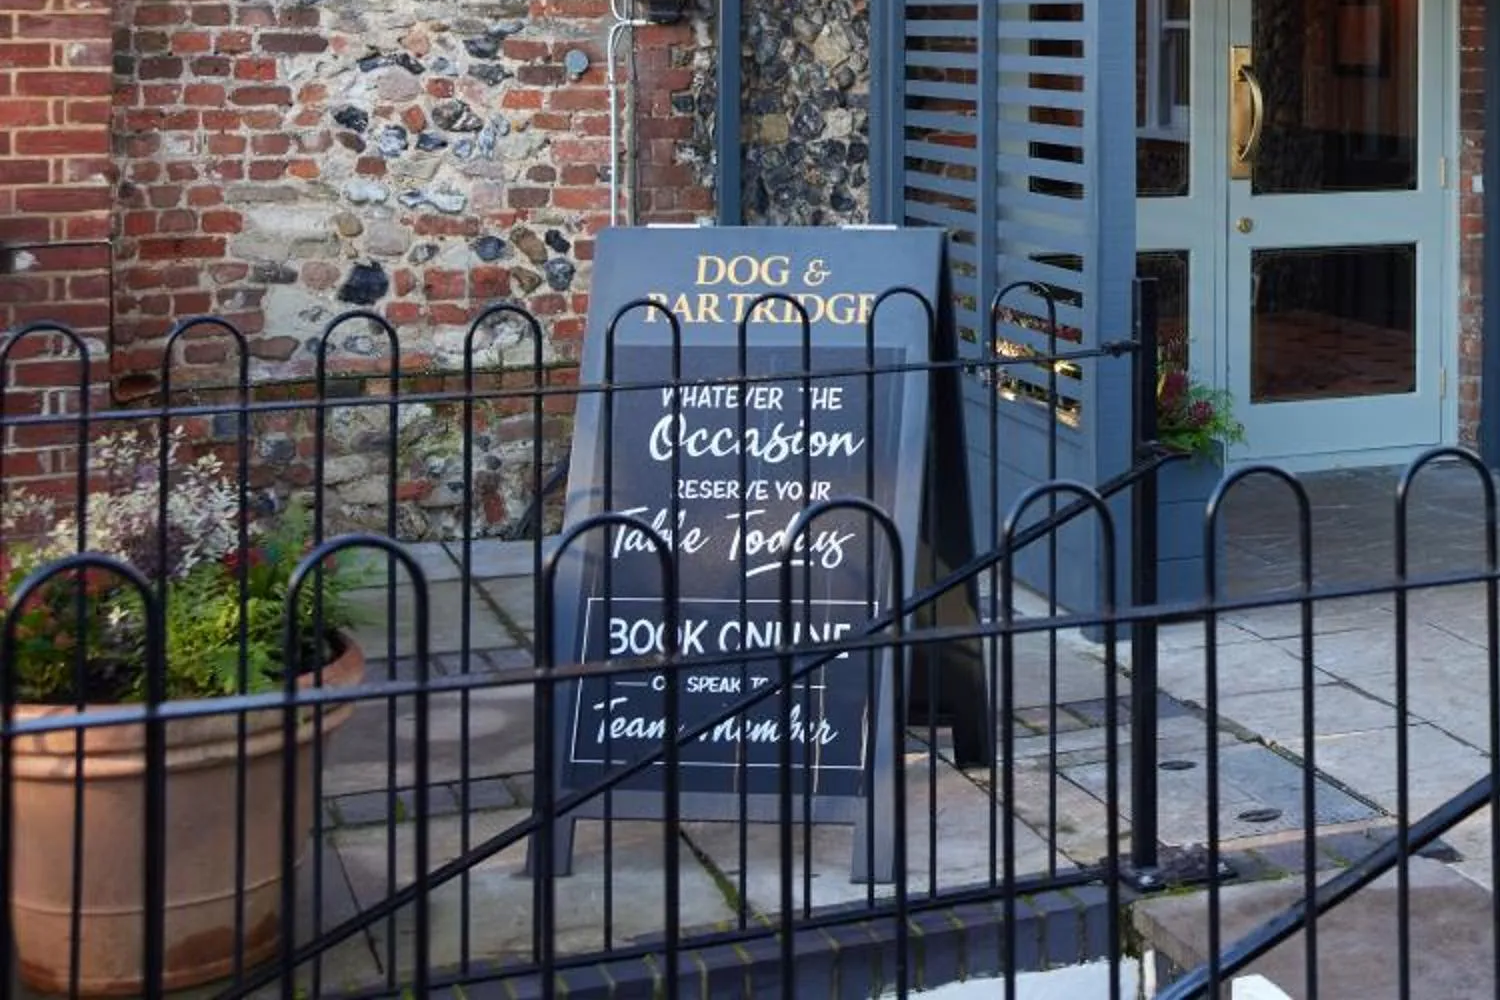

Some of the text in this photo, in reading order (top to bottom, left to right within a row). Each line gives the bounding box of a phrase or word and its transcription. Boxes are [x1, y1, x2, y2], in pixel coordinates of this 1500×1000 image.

[694, 254, 832, 287] DOG &
[687, 675, 742, 693] SPEAK
